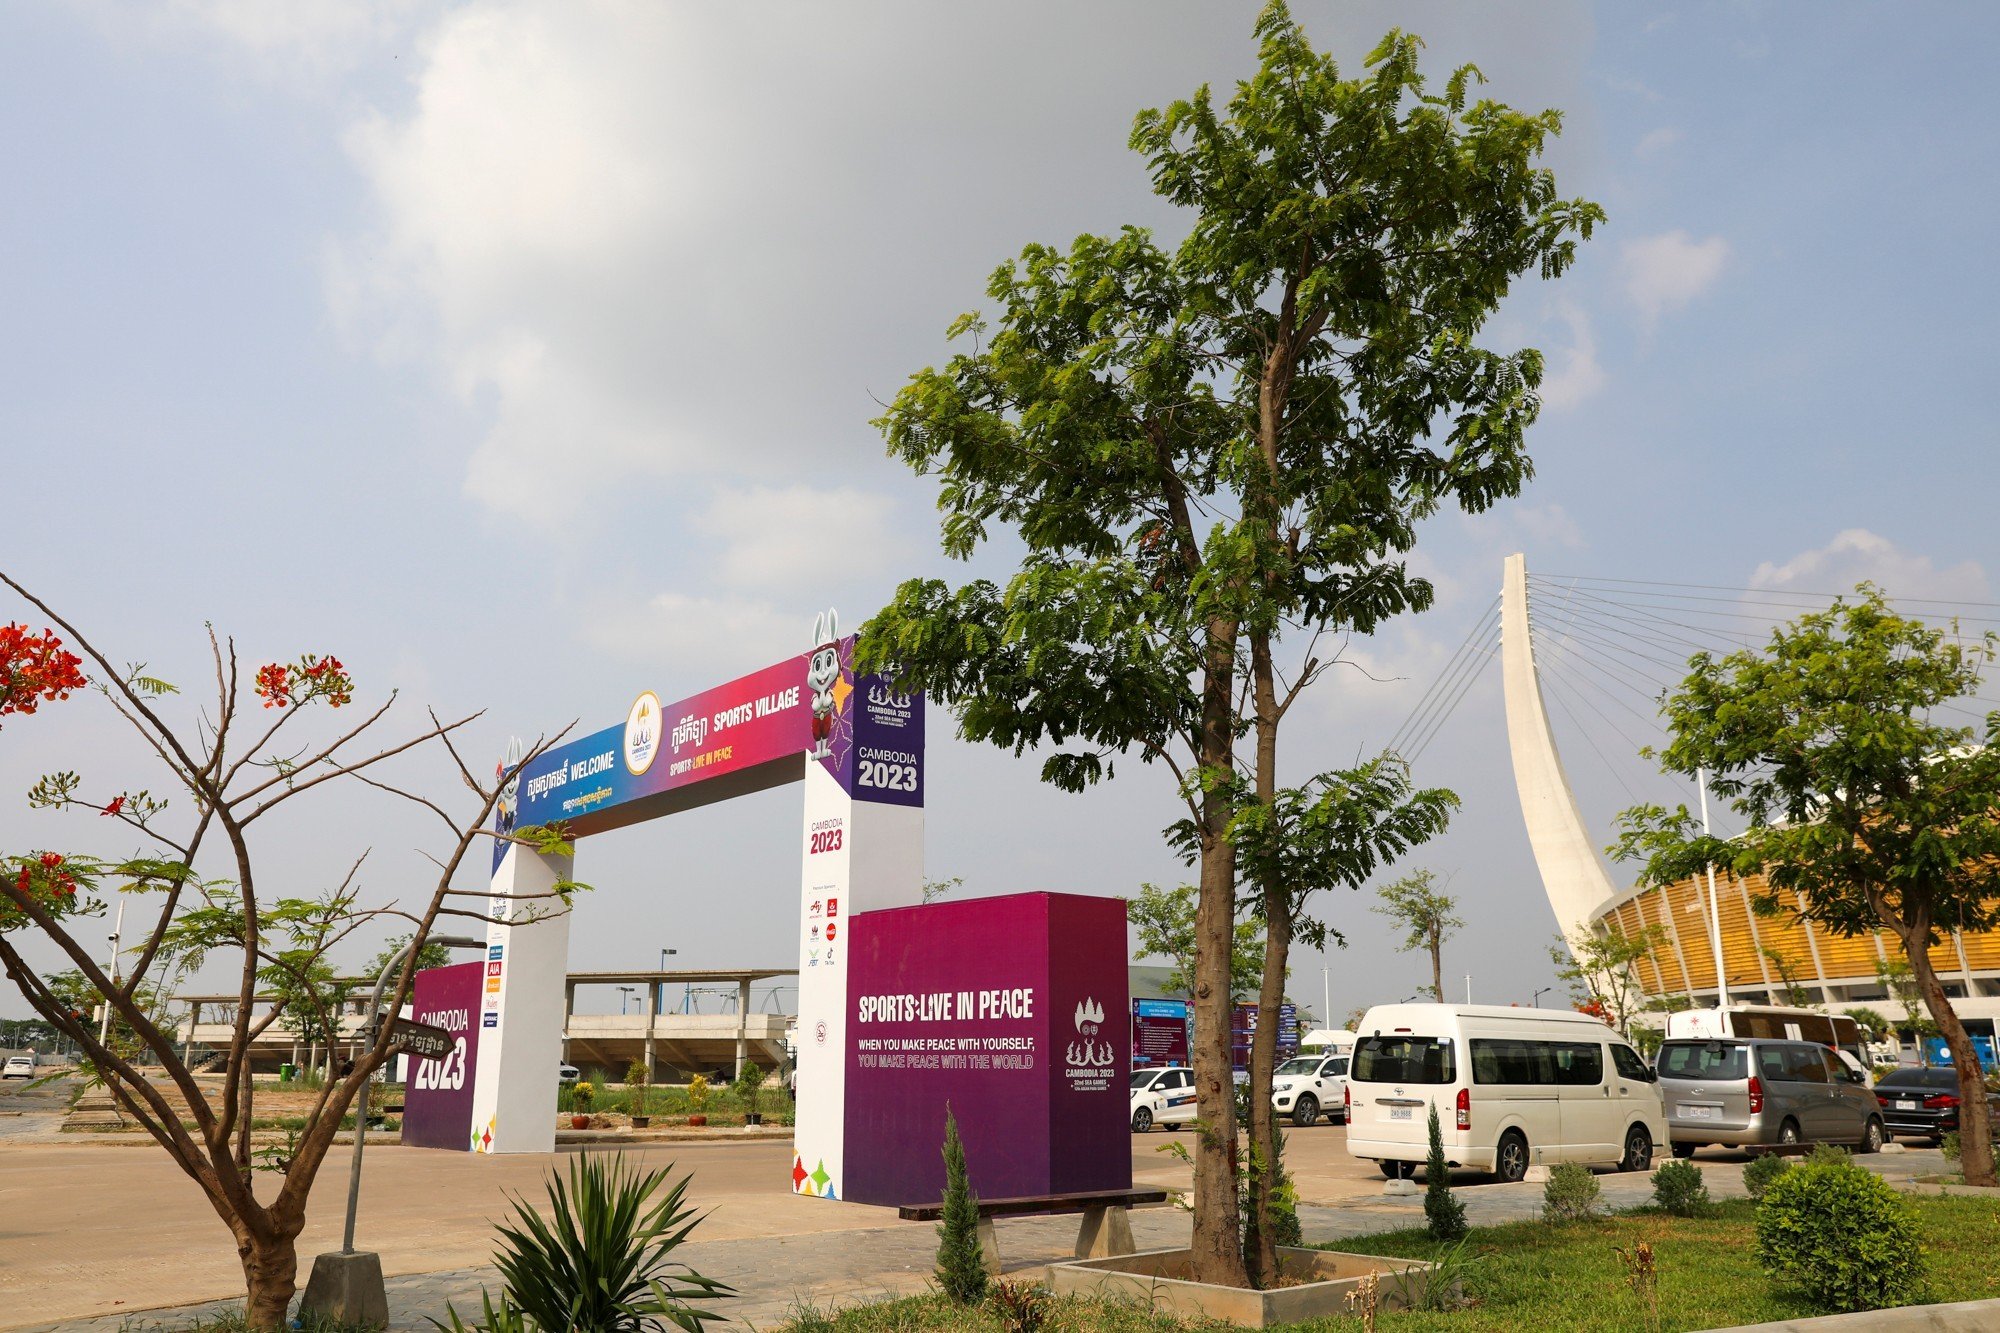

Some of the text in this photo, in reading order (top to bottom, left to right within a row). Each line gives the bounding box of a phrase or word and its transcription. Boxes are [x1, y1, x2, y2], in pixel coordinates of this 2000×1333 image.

[713, 685, 800, 732] SPORTS VILLAGE
[867, 705, 911, 718] CAMBODIA 2023
[706, 752, 713, 766] IN
[713, 746, 732, 763] PEACE
[858, 746, 917, 765] CAMBODIA
[571, 750, 615, 781] WELCOME
[858, 760, 917, 792] 2023
[811, 817, 843, 832] CAMBODIA
[810, 829, 842, 855] 2023
[489, 963, 500, 975] AIA
[956, 991, 974, 1020] IN
[979, 988, 1033, 1020] PEACE
[858, 1037, 1035, 1052] WHEN YOU MAKE PEACE WITH YOURSELF,
[858, 1054, 1034, 1070] YOU MAKE PEACE WITH THE WORLD
[1065, 1069, 1115, 1078] CAMBODIA 2023
